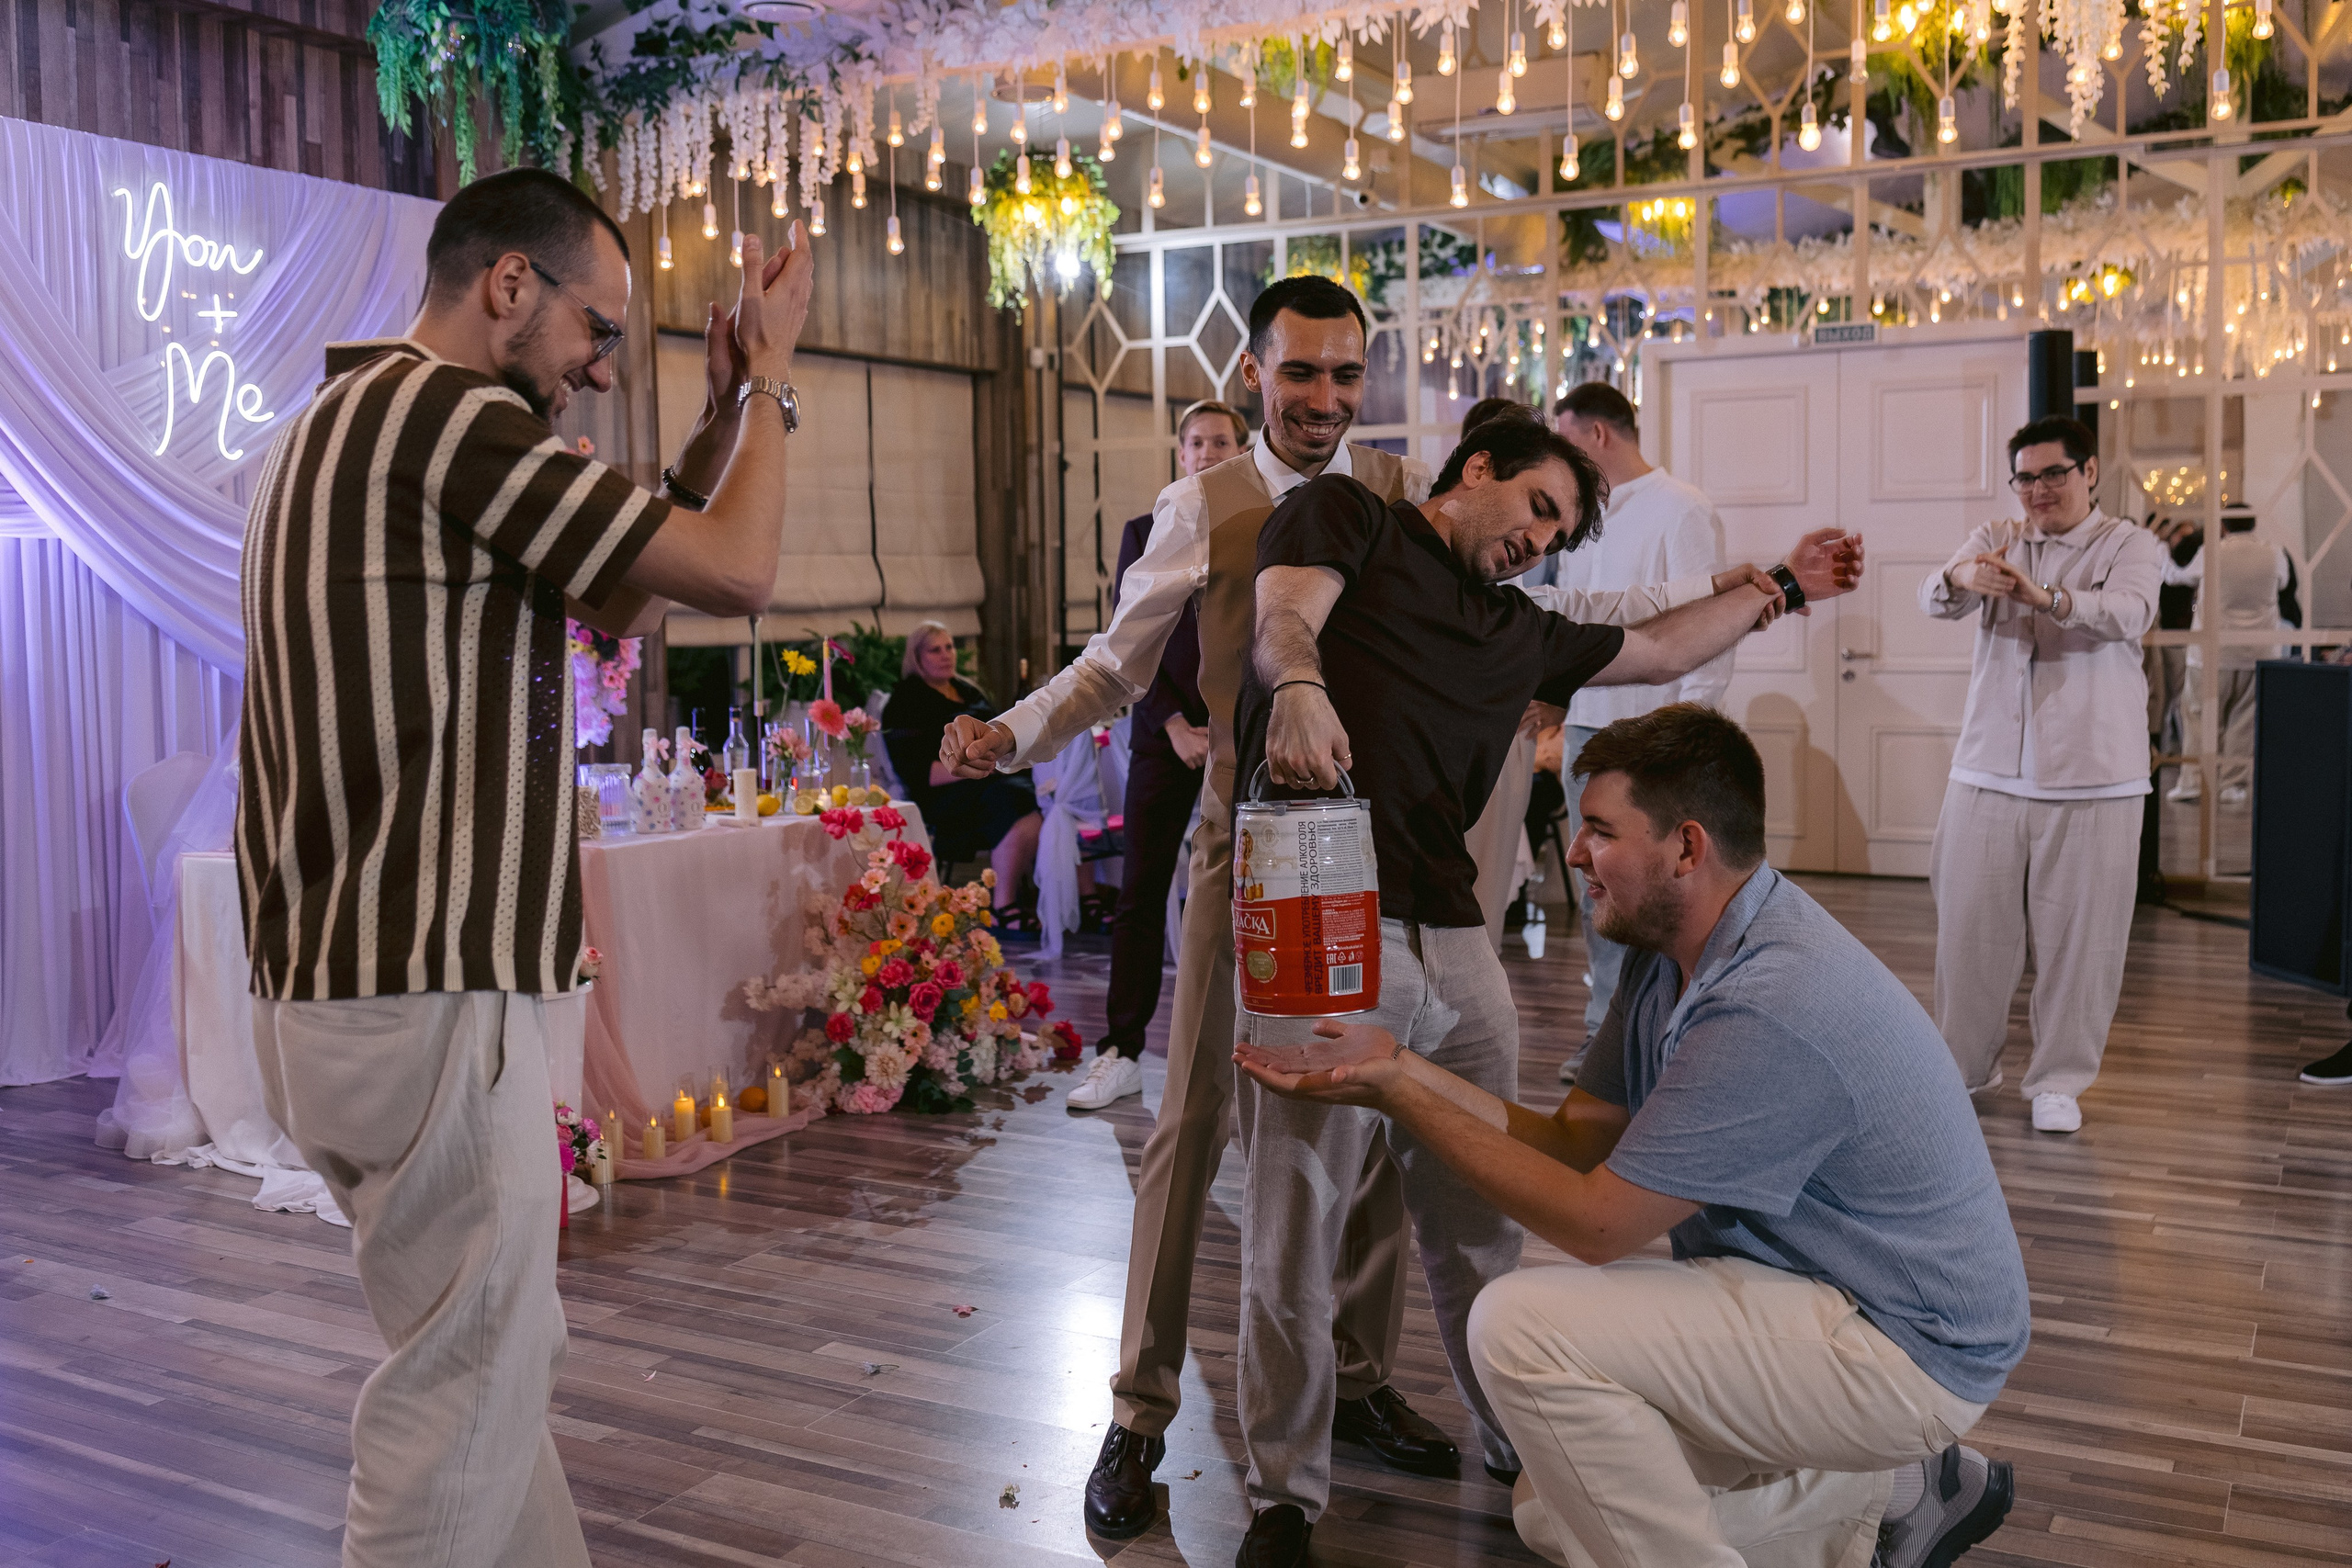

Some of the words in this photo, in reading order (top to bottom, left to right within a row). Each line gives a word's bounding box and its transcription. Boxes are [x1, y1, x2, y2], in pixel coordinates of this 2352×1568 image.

[114, 182, 264, 321] You
[198, 294, 238, 333] +
[154, 342, 275, 460] Me
[1298, 820, 1307, 869] АЛКОГОЛЯ
[1308, 820, 1320, 890] ЗДОРОВЬЮ
[1300, 871, 1311, 938] УПОТРЕБЛЕНИЕ
[1310, 894, 1322, 945] ВАШЕМУ
[1303, 941, 1313, 996] ЧРЕЗМЕРНОЕ
[1314, 950, 1324, 995] ВРЕДИТ
